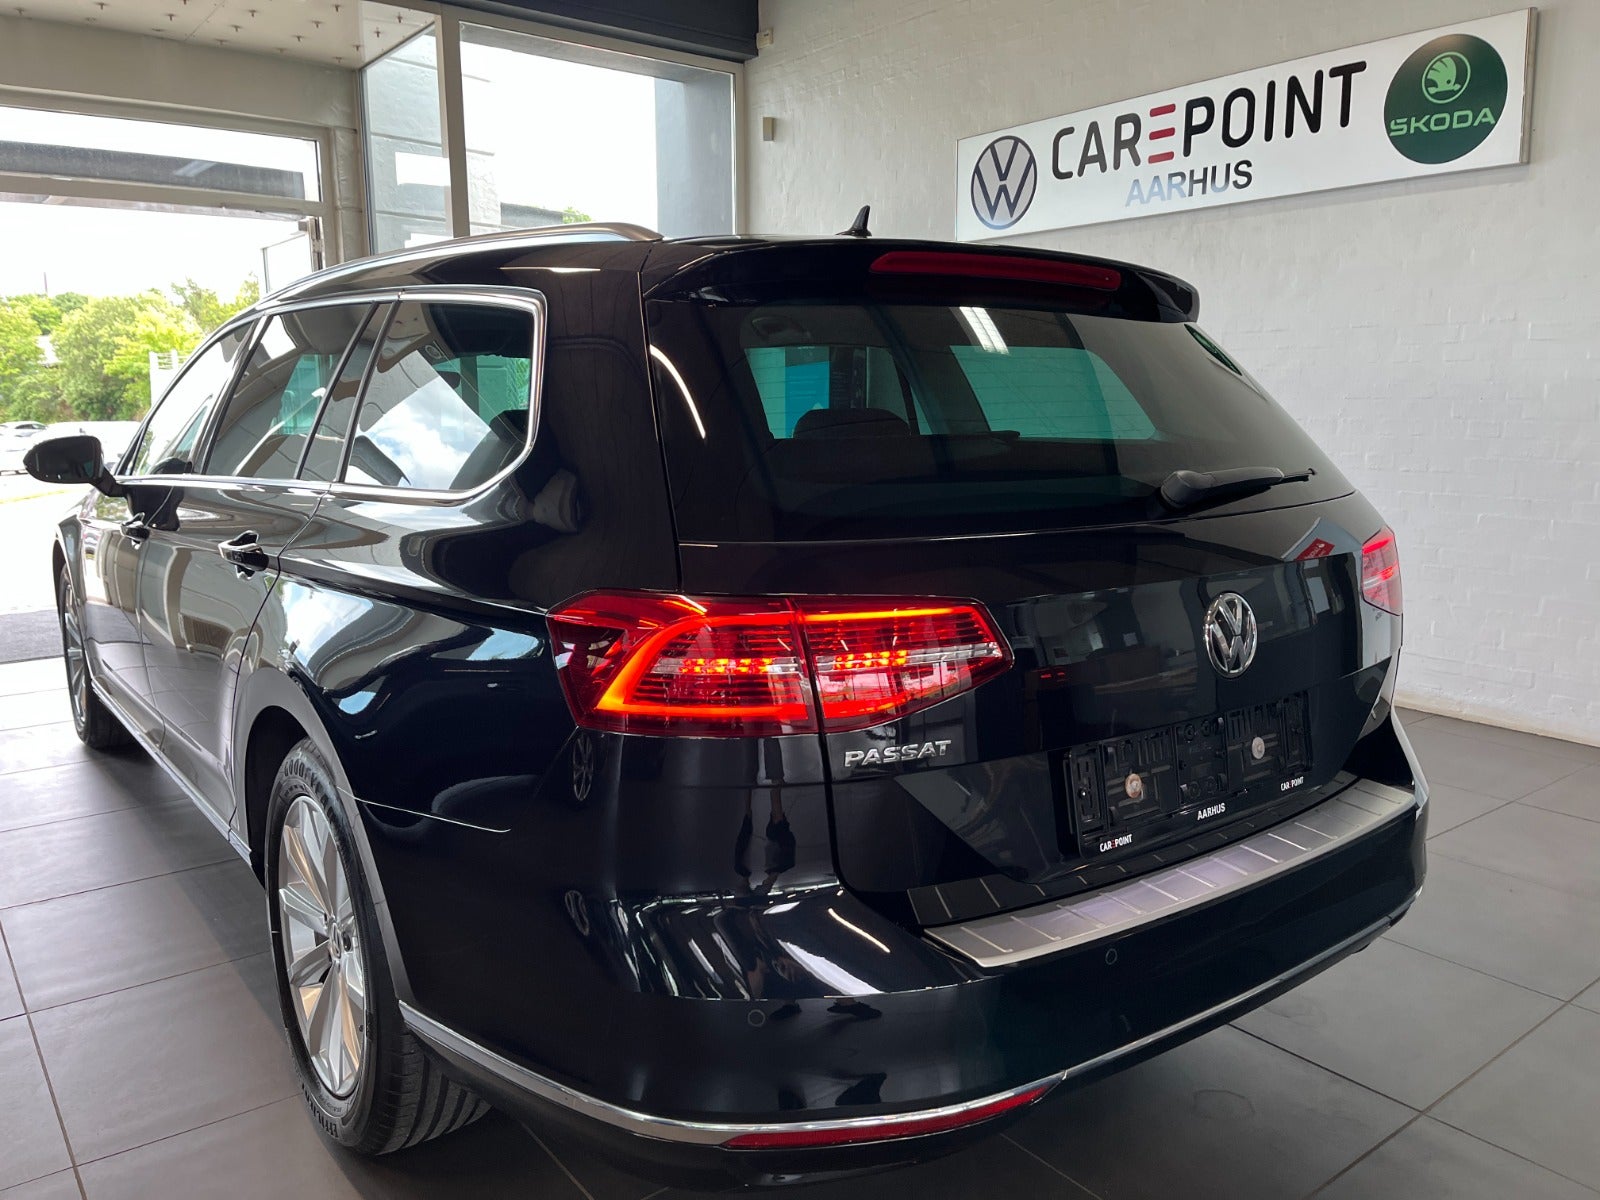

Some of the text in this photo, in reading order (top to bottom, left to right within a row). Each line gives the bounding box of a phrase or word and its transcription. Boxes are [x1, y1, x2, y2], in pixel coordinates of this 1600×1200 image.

[1124, 159, 1253, 207] AARHUS
[844, 739, 952, 767] PASSAT
[1197, 802, 1226, 820] AARHUS
